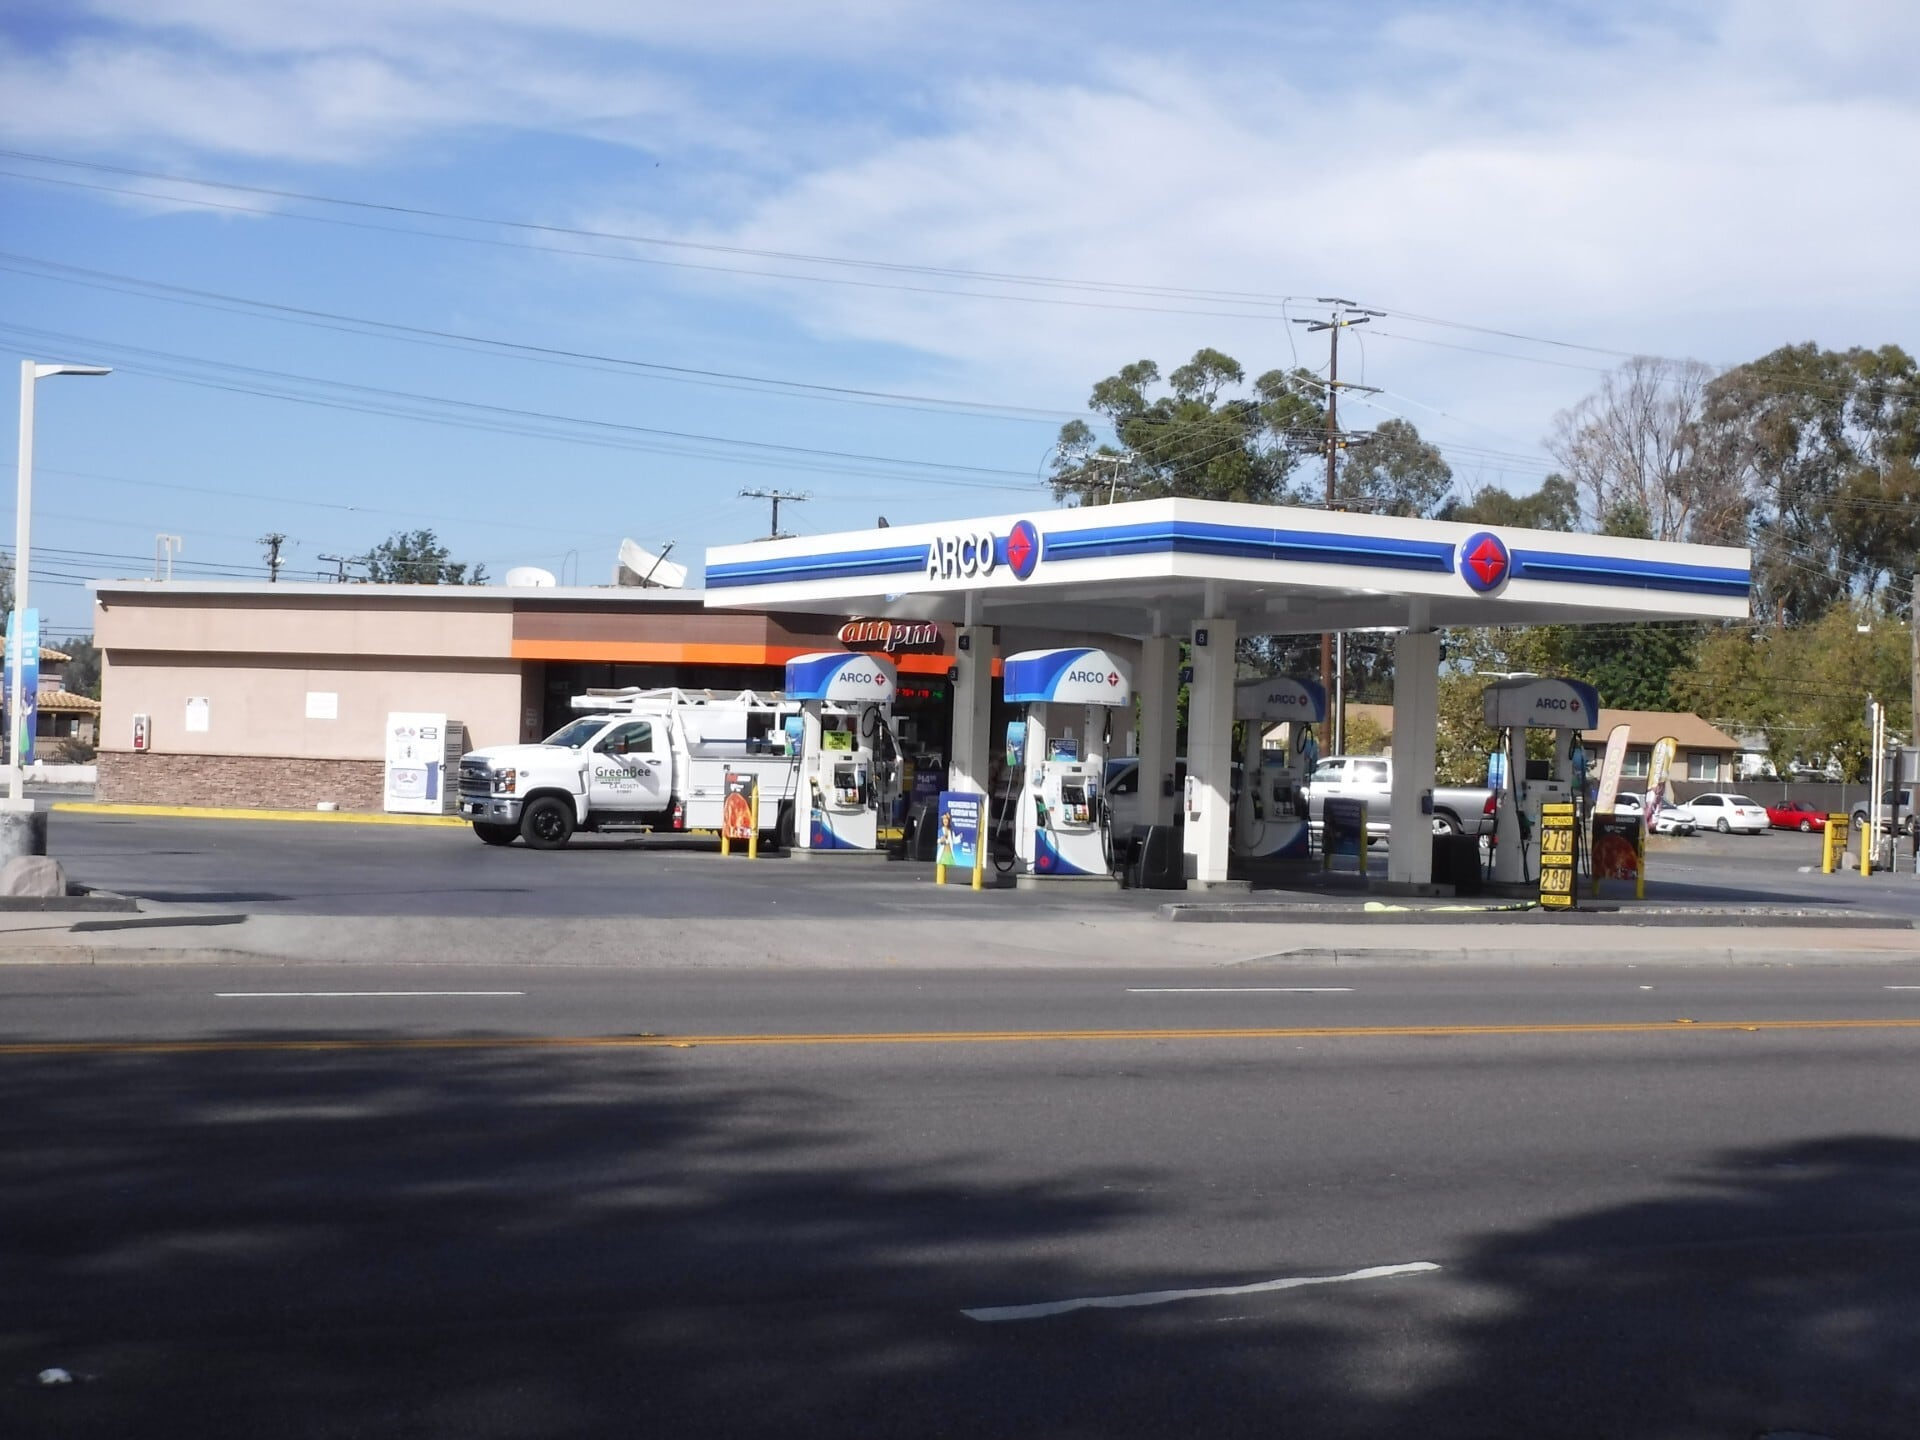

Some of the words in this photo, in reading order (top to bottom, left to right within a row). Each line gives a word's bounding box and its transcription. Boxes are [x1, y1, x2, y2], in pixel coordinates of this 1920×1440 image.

[926, 532, 996, 578] ARCO
[838, 620, 938, 653] ampm
[839, 671, 872, 684] ARCO
[1068, 671, 1104, 684] ARCO
[1267, 693, 1297, 705] ARCO
[1535, 698, 1567, 710] ARCO
[595, 766, 651, 778] GreenBee
